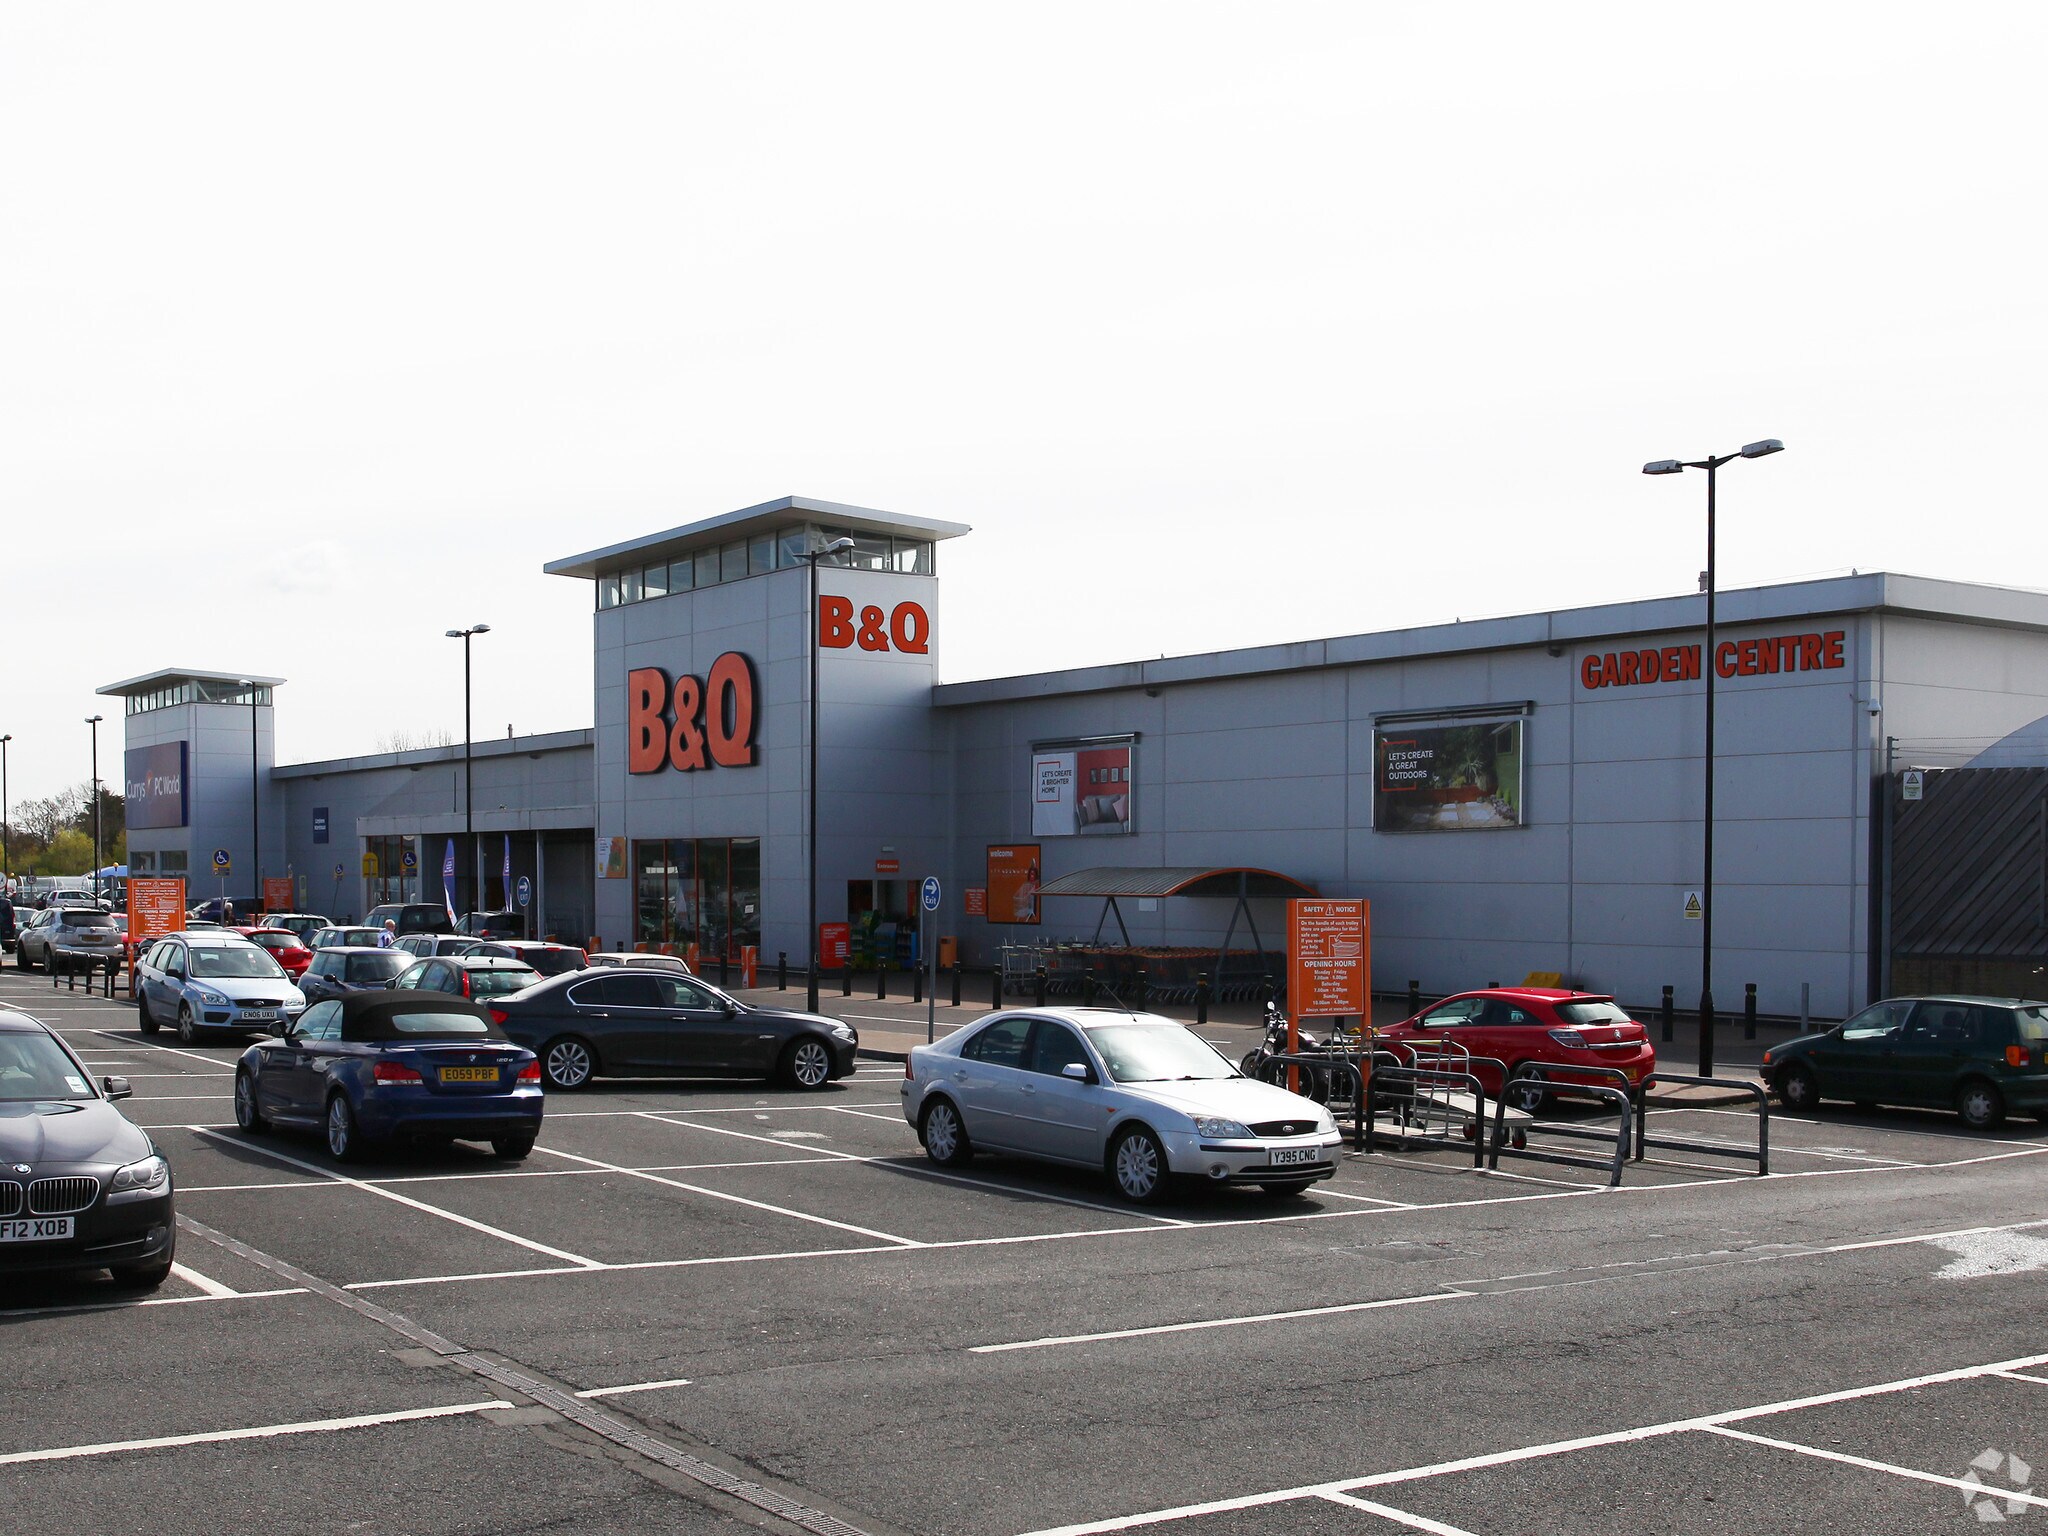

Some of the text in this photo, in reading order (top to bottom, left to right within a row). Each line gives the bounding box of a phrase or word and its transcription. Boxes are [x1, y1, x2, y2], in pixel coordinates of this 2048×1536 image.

[819, 594, 929, 654] B&Q
[1580, 630, 1845, 690] GARDEN CENTRE
[628, 651, 756, 775] B&Q
[1388, 750, 1433, 760] LET'S CREATE
[1395, 761, 1418, 769] GREAT
[1041, 769, 1072, 778] LET'S CREATE
[1388, 770, 1428, 780] OUTDOORS
[126, 774, 180, 802] Currys PC World
[925, 896, 937, 905] Exit
[445, 1069, 494, 1080] EO59 PBF
[1274, 1149, 1316, 1163] Y395 CNG
[34, 1219, 68, 1237] XOB
